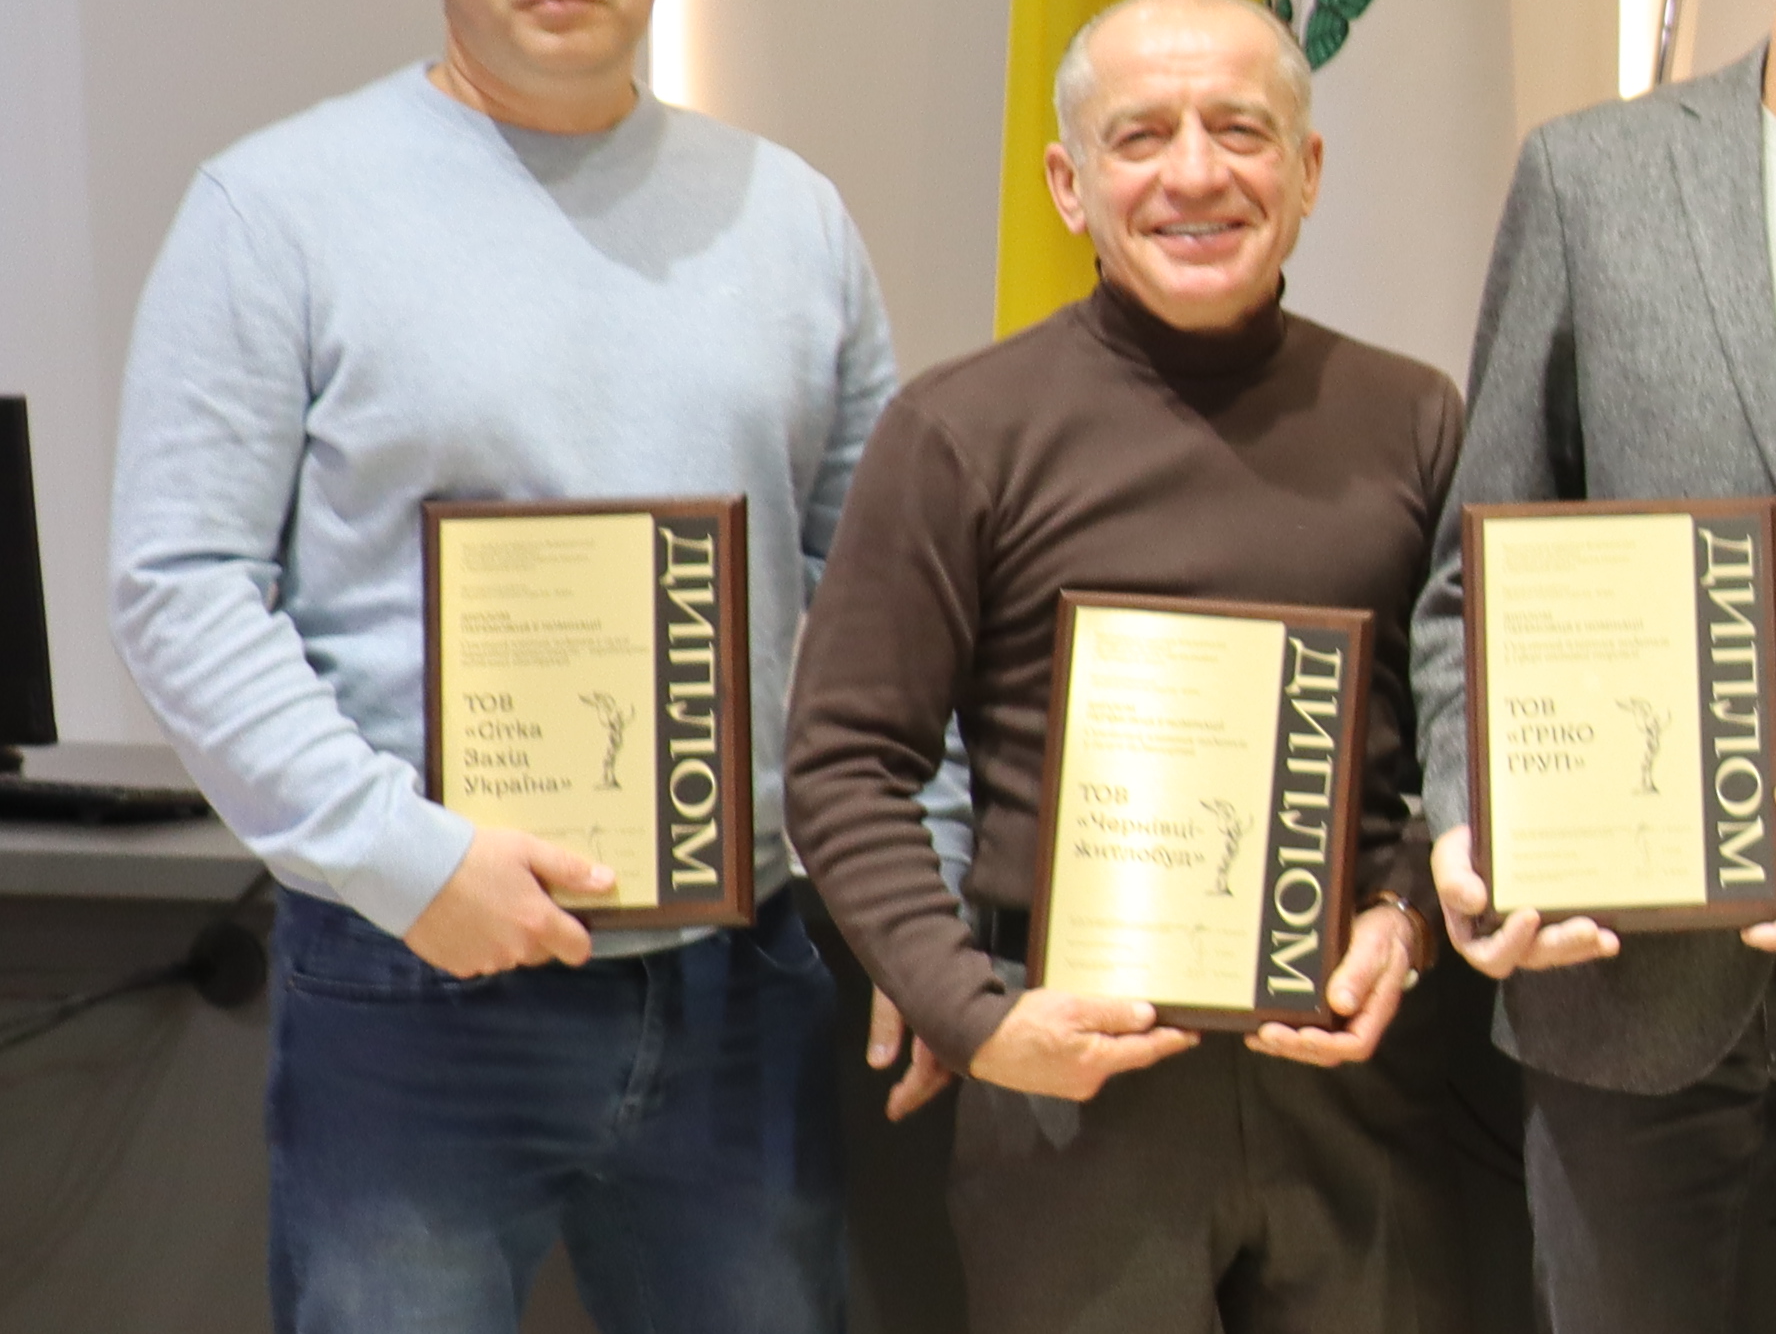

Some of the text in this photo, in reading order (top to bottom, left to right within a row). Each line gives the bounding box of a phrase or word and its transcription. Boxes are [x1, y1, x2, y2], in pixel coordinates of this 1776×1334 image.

[462, 692, 514, 713] ТОВ
[659, 527, 719, 892] ДИПЛОМ
[1078, 781, 1129, 804] ТОВ
[1503, 696, 1555, 718] ТОВ
[1698, 527, 1766, 889] ДИПЛОМ
[1268, 637, 1343, 996] ДИПЛОМ
